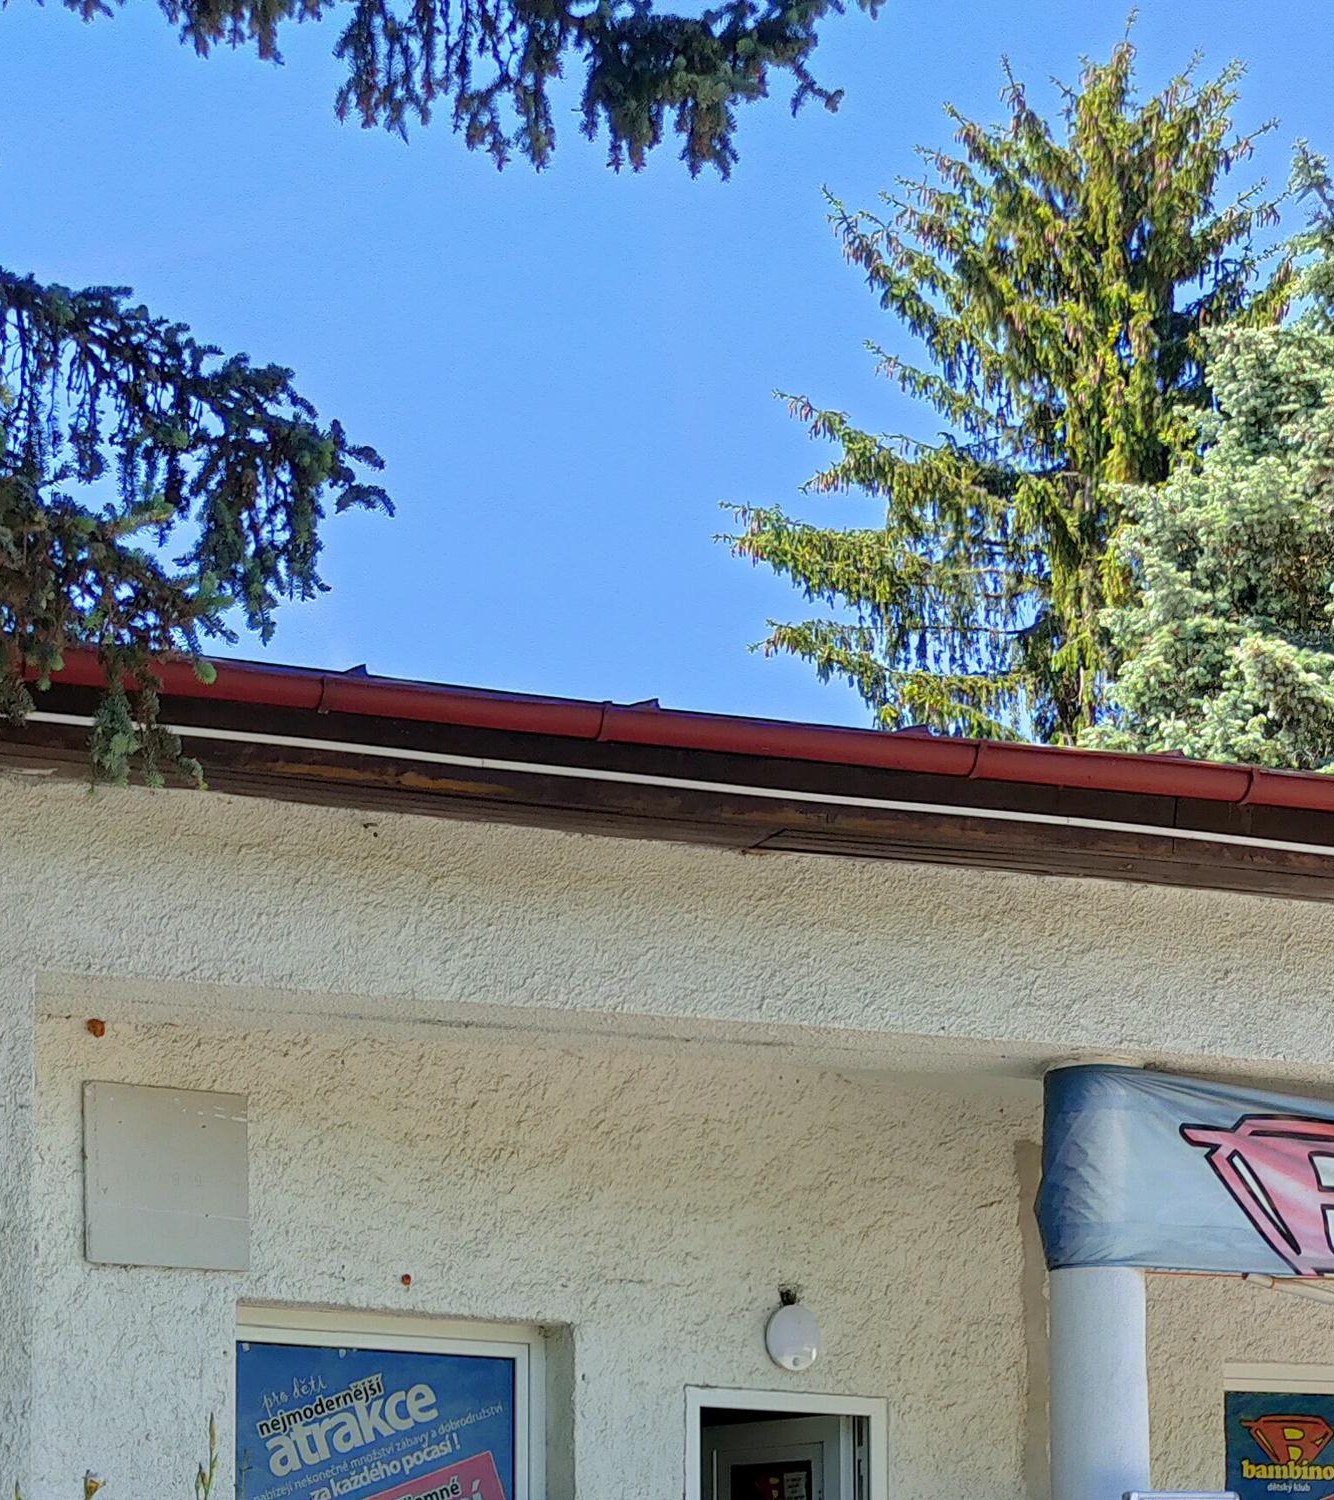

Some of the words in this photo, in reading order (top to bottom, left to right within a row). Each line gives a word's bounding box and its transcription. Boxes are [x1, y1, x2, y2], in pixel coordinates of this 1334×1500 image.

[257, 1375, 383, 1437] nejmodernější
[262, 1391, 289, 1417] pro
[293, 1376, 327, 1398] děti
[267, 1384, 439, 1476] atrakce
[294, 1463, 348, 1489] nekonečné
[351, 1442, 394, 1469] množství
[396, 1430, 429, 1451] zábavy
[431, 1428, 437, 1438] a
[438, 1402, 503, 1434] dobrodružství
[330, 1459, 401, 1497] každého
[402, 1437, 452, 1475] počasí
[1293, 1483, 1311, 1492] klub
